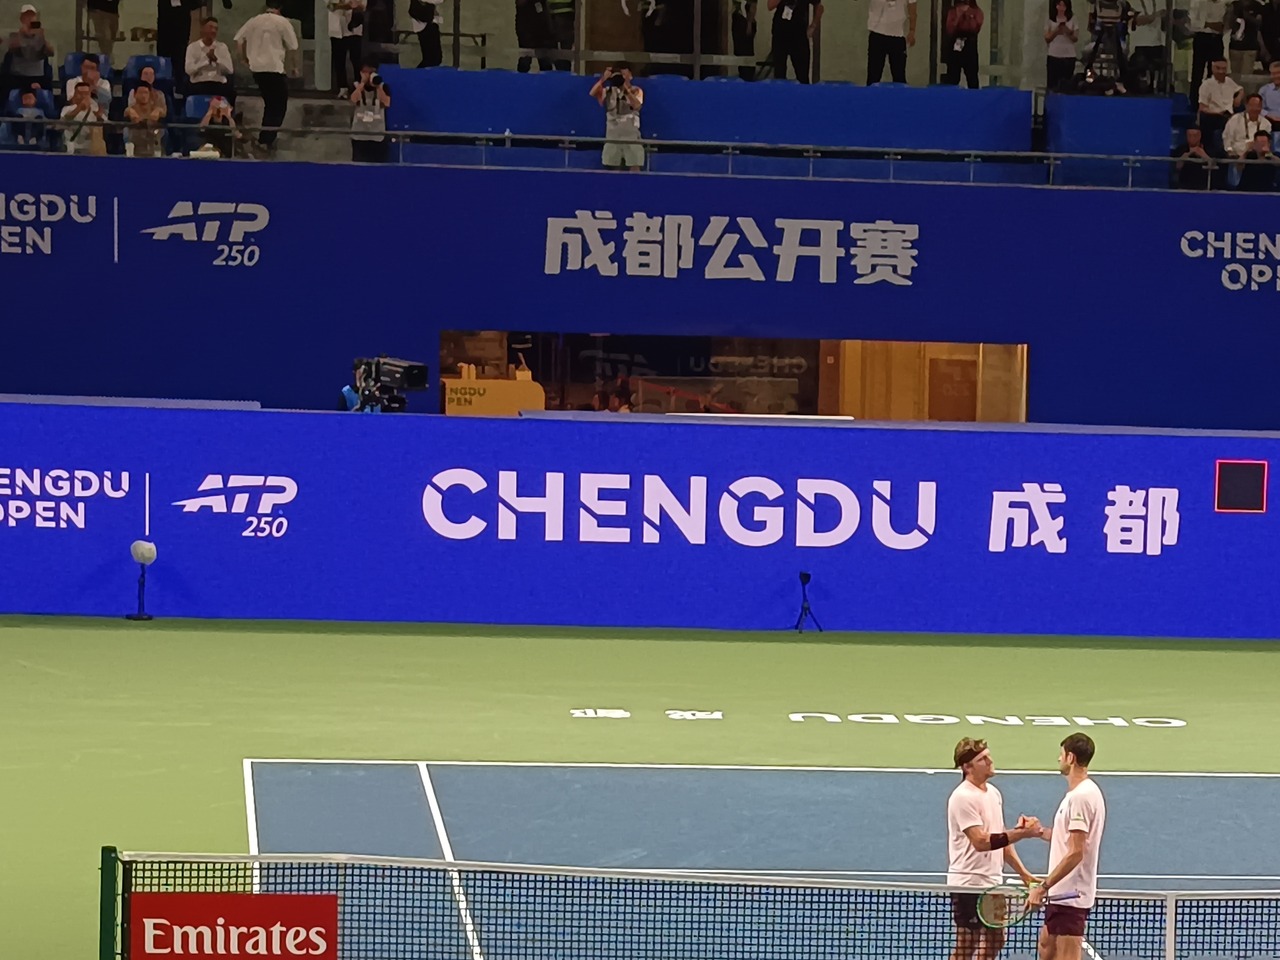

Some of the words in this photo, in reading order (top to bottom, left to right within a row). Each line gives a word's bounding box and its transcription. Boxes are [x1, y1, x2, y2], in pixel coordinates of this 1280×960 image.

[0, 192, 97, 223] GDU
[140, 201, 270, 242] ATP
[212, 244, 260, 267] 250
[544, 210, 920, 286] 成都公开赛
[172, 474, 298, 514] ATP
[422, 468, 937, 550] CHENGDU
[0, 499, 85, 529] PEN
[241, 516, 288, 538] 250
[788, 713, 1188, 727] CHENGDU
[142, 917, 327, 955] Emirates
